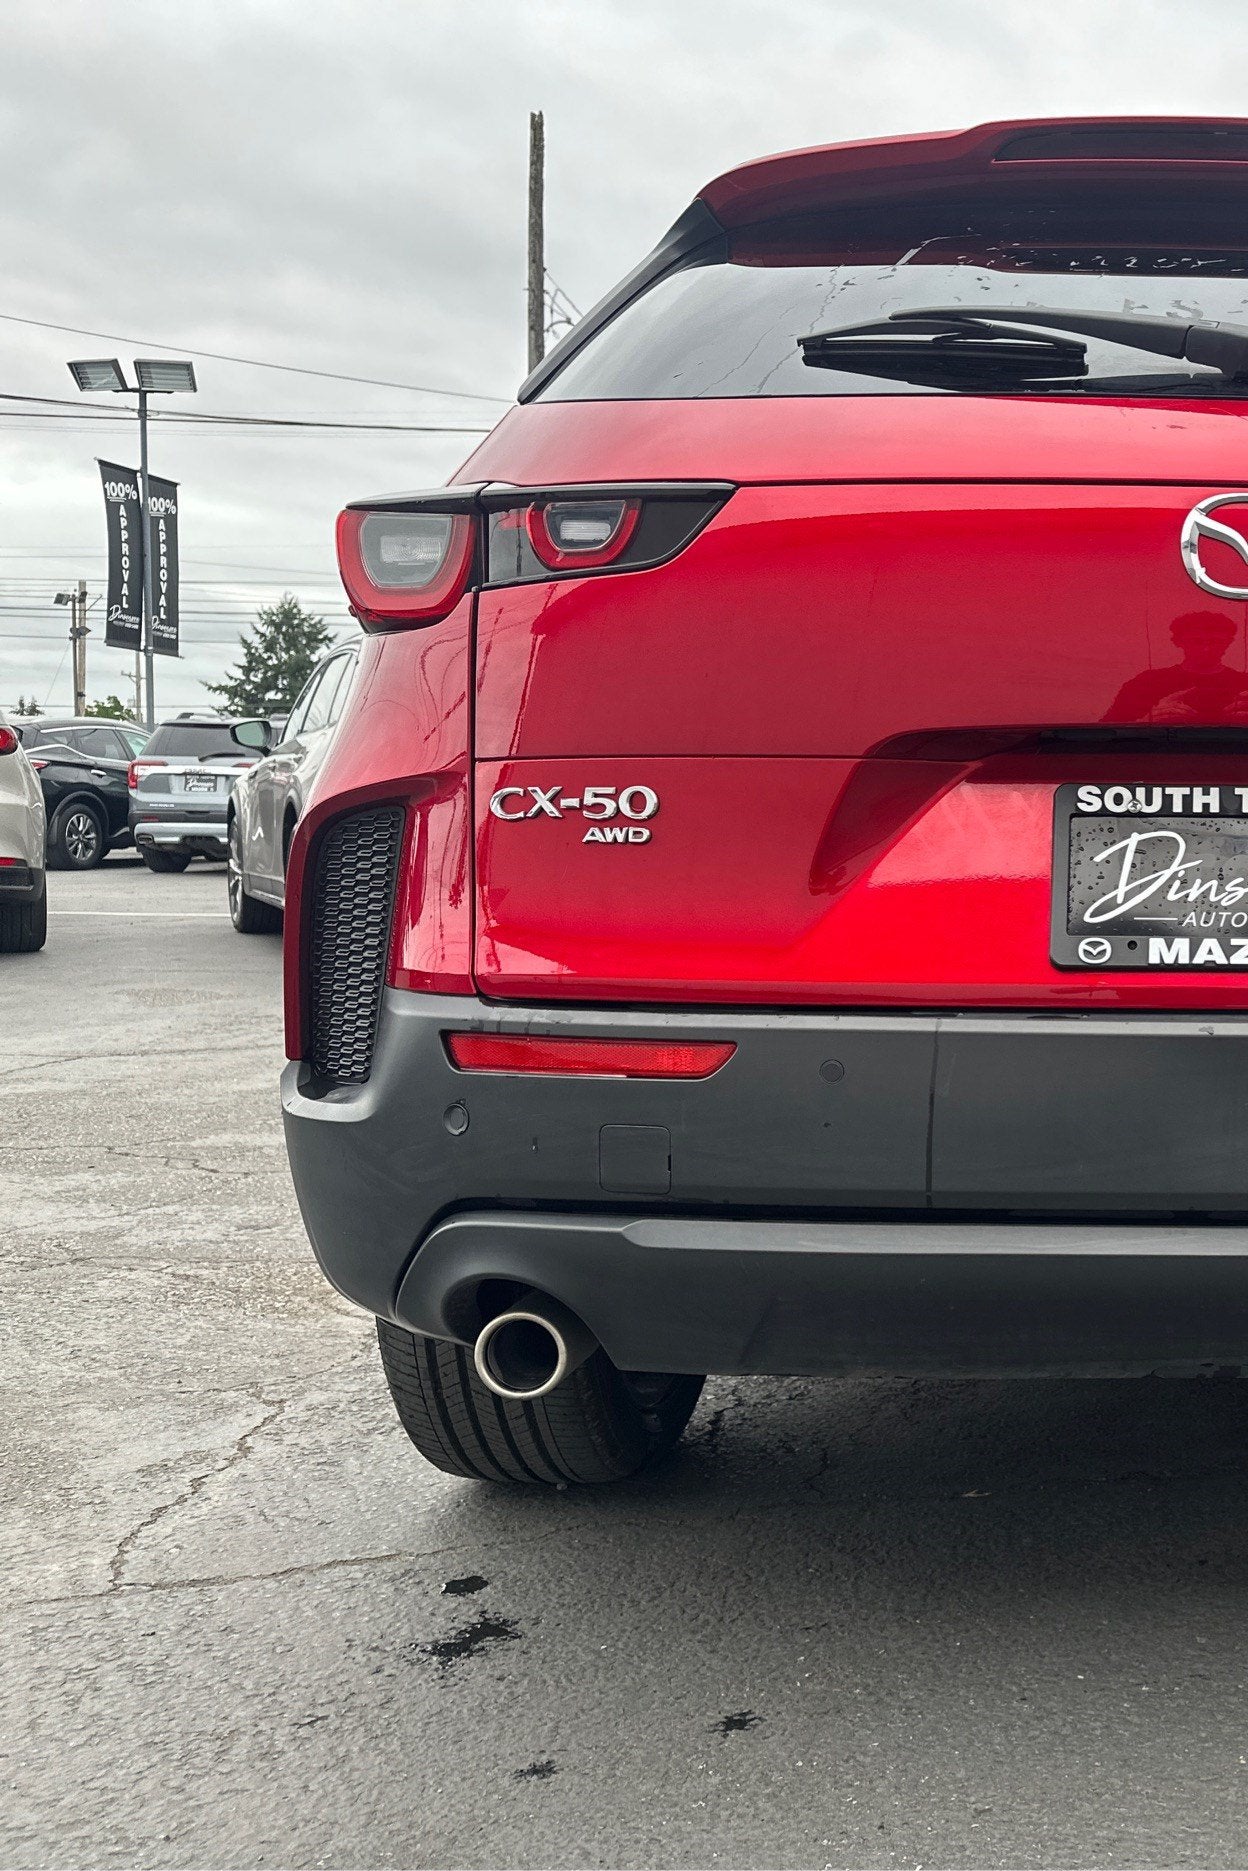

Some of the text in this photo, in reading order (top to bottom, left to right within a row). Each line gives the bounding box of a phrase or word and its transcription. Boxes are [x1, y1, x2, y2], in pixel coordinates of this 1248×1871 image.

[105, 482, 137, 500] 100%
[148, 497, 176, 514] 100%
[119, 505, 130, 609] APPROVAL
[158, 519, 168, 619] APPROVAL
[490, 785, 659, 820] CX-50
[1076, 785, 1220, 813] SOUTH
[582, 827, 650, 843] AWD
[1182, 911, 1248, 929] AUTO
